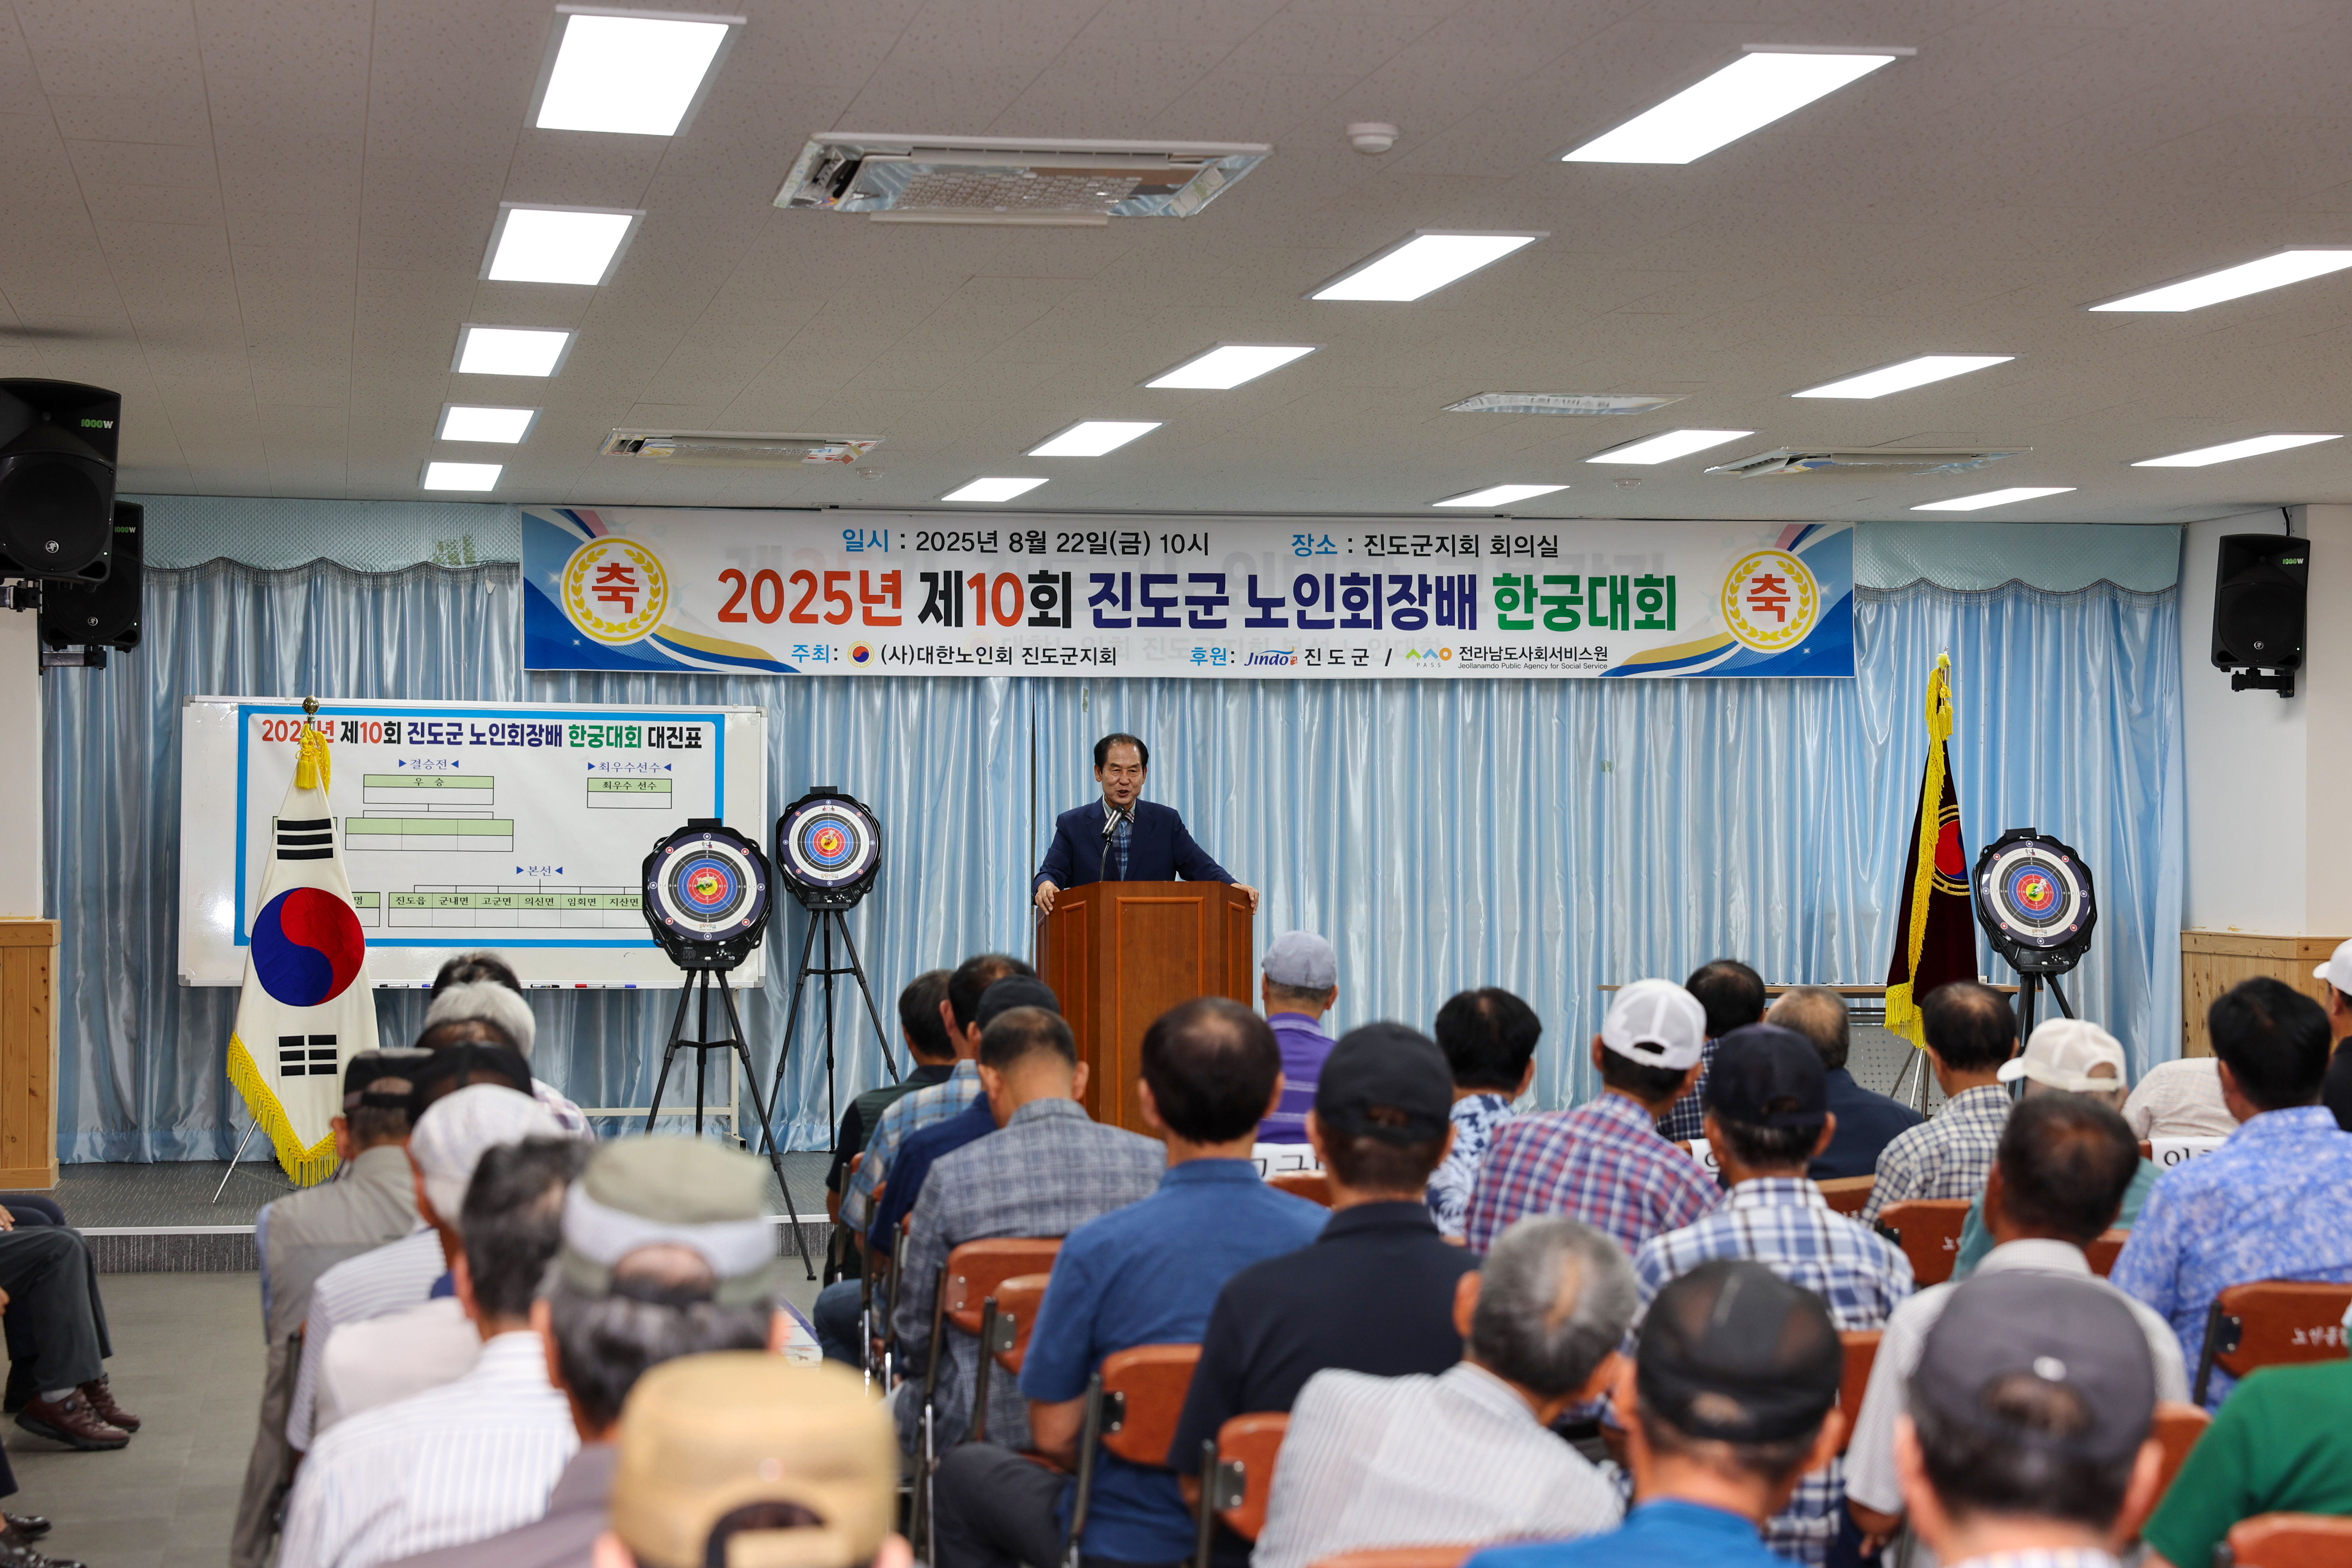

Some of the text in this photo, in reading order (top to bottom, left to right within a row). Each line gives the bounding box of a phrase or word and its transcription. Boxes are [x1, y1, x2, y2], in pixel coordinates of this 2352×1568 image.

[81, 419, 113, 429] 1000W
[842, 529, 888, 552] 일시
[916, 530, 998, 553] 2025년
[1009, 530, 1046, 554] 8월
[1056, 530, 1151, 556] 22일(금)
[1160, 532, 1209, 556] 10시
[1292, 534, 1338, 557] 장소
[1364, 534, 1479, 557] 진도군지회
[1490, 535, 1558, 558] 회의실
[592, 562, 639, 614] 축
[718, 568, 1677, 632] 2025년 제10회 진도군 노인회장배 한궁대회
[1746, 575, 1791, 622] 축
[791, 644, 1116, 666] 주최: (사)대한노인회 진도군지회
[1190, 647, 1235, 666] 후원:
[1244, 652, 1289, 666] Jindo
[1459, 646, 1608, 662] 전라남도사회서비스원
[262, 719, 702, 750] 202년 제10회 진도군 노인회장배 한궁대회 대진표
[410, 759, 447, 770] 결승전
[599, 762, 661, 773] 최우수선수
[603, 781, 657, 790] 최우수 선수
[527, 866, 551, 877] 본선
[395, 896, 426, 906] 진도읍
[438, 897, 469, 906] 군내면
[481, 897, 512, 906] 고군면
[524, 897, 555, 906] 의신면
[567, 897, 597, 907] 임회면
[610, 898, 639, 907] 지산면
